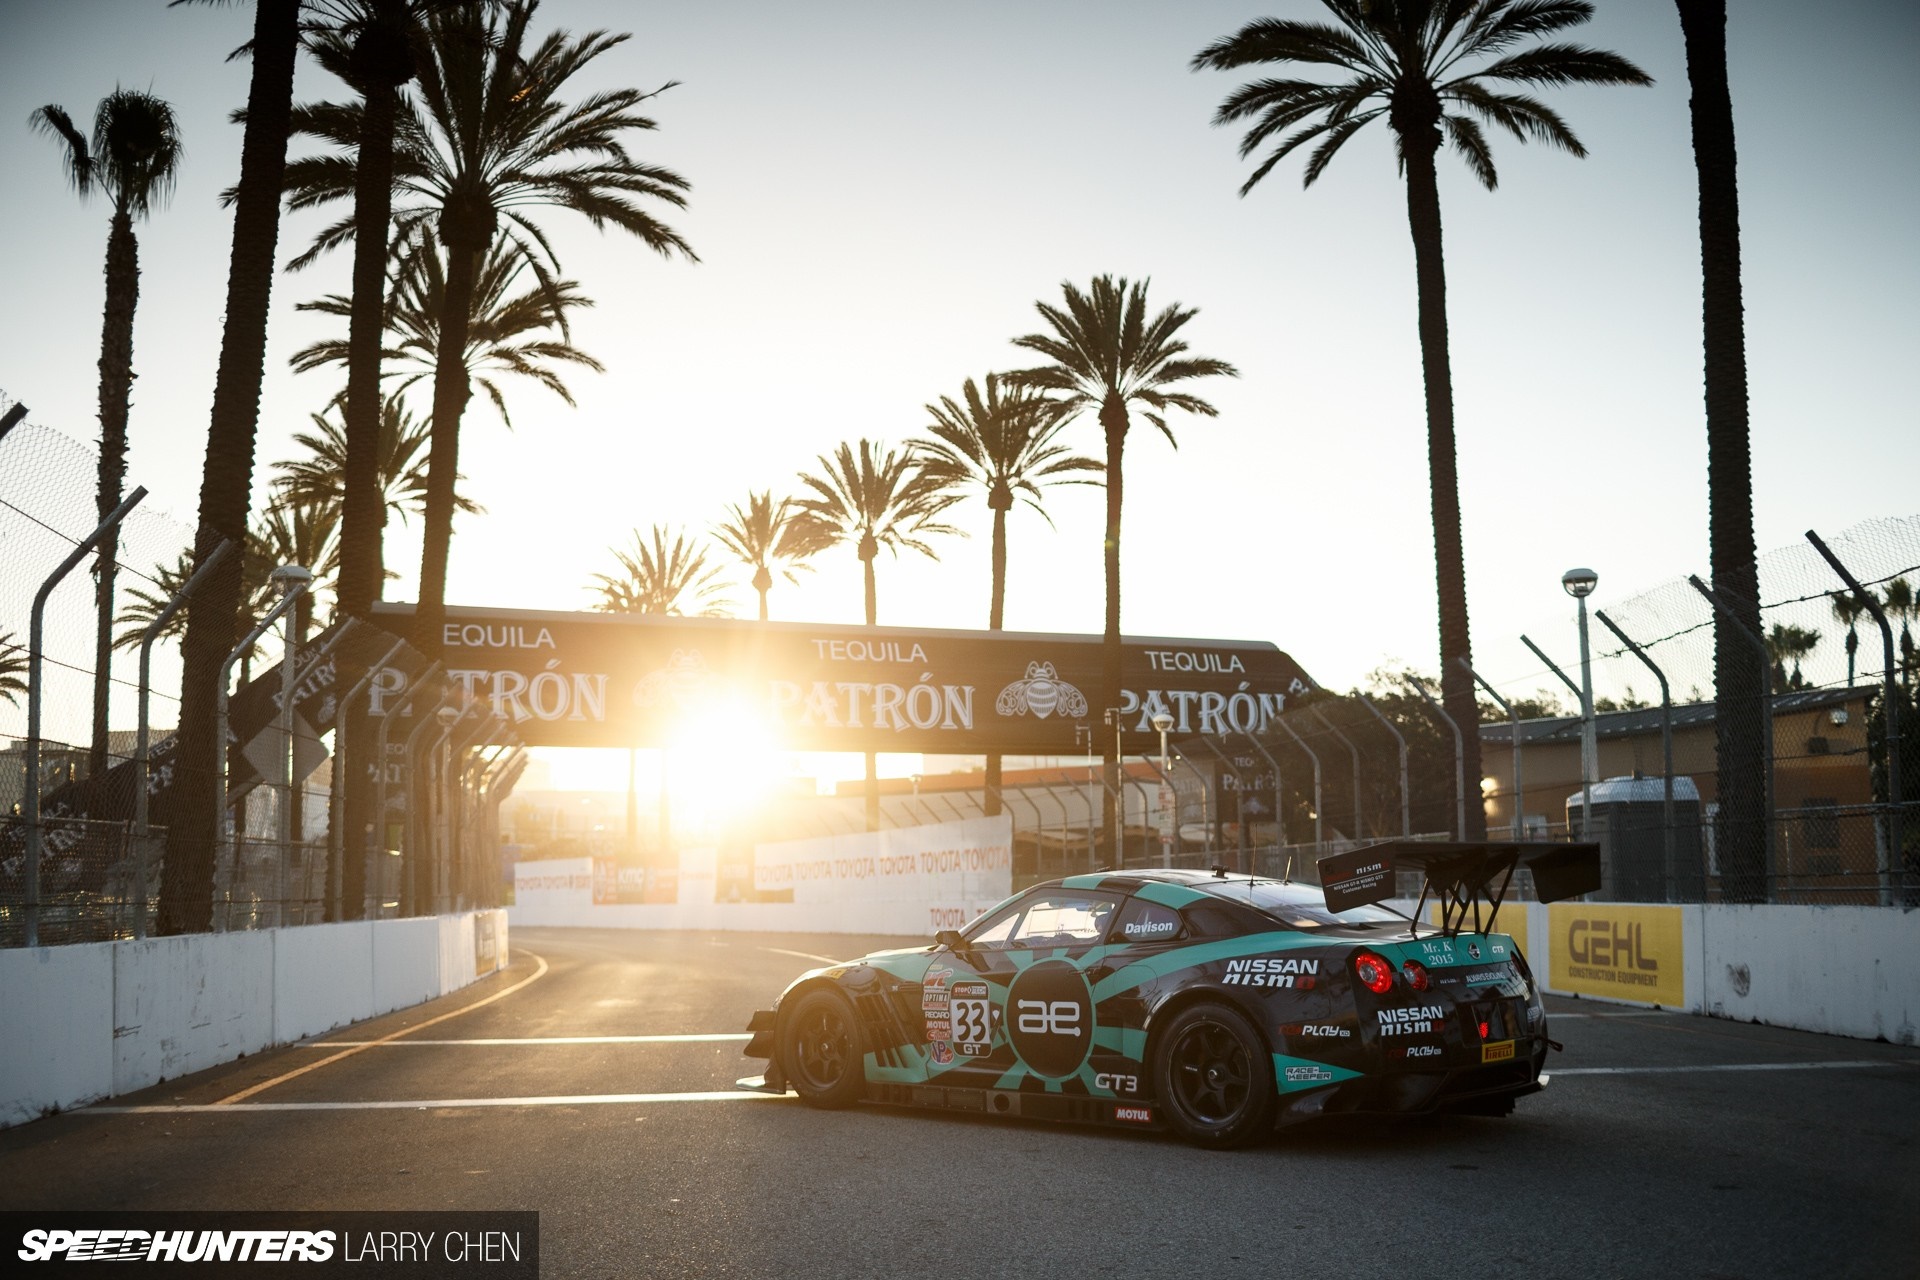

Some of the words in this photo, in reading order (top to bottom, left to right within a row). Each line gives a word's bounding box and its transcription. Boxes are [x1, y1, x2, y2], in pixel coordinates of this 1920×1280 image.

[443, 624, 556, 649] EQUILA
[811, 639, 928, 663] TEQUILA
[1144, 651, 1246, 673] TEQUILA
[368, 659, 608, 724] PTRÓN
[768, 672, 976, 732] PATRÓN
[795, 860, 832, 880] TOYOTA
[835, 857, 876, 878] TOYOTA
[879, 855, 917, 875] TOYOTA
[920, 851, 962, 874] TOYOTA
[964, 846, 1010, 872] TOYOTA
[929, 908, 966, 928] TOYOTA
[1124, 921, 1174, 934] Davison
[1422, 943, 1441, 954] Mr.
[1443, 941, 1453, 951] K
[1568, 918, 1658, 971] GEHL
[1226, 959, 1319, 975] NISSAN
[1428, 954, 1454, 966] 2015
[1568, 966, 1617, 982] CONSTRUCTION
[1617, 971, 1658, 987] EQUIPMENT
[925, 993, 948, 1002] OPTIMA
[924, 1011, 950, 1019] RECARO
[956, 1002, 986, 1042] 33
[1377, 1006, 1443, 1024] NISSAN
[926, 1020, 951, 1030] MOTUL
[963, 1043, 981, 1055] GT
[1485, 1043, 1513, 1060] PIRELLI
[1094, 1073, 1138, 1092] GT3
[1288, 1073, 1331, 1081] KEEPER
[1116, 1109, 1150, 1120] MOTUL
